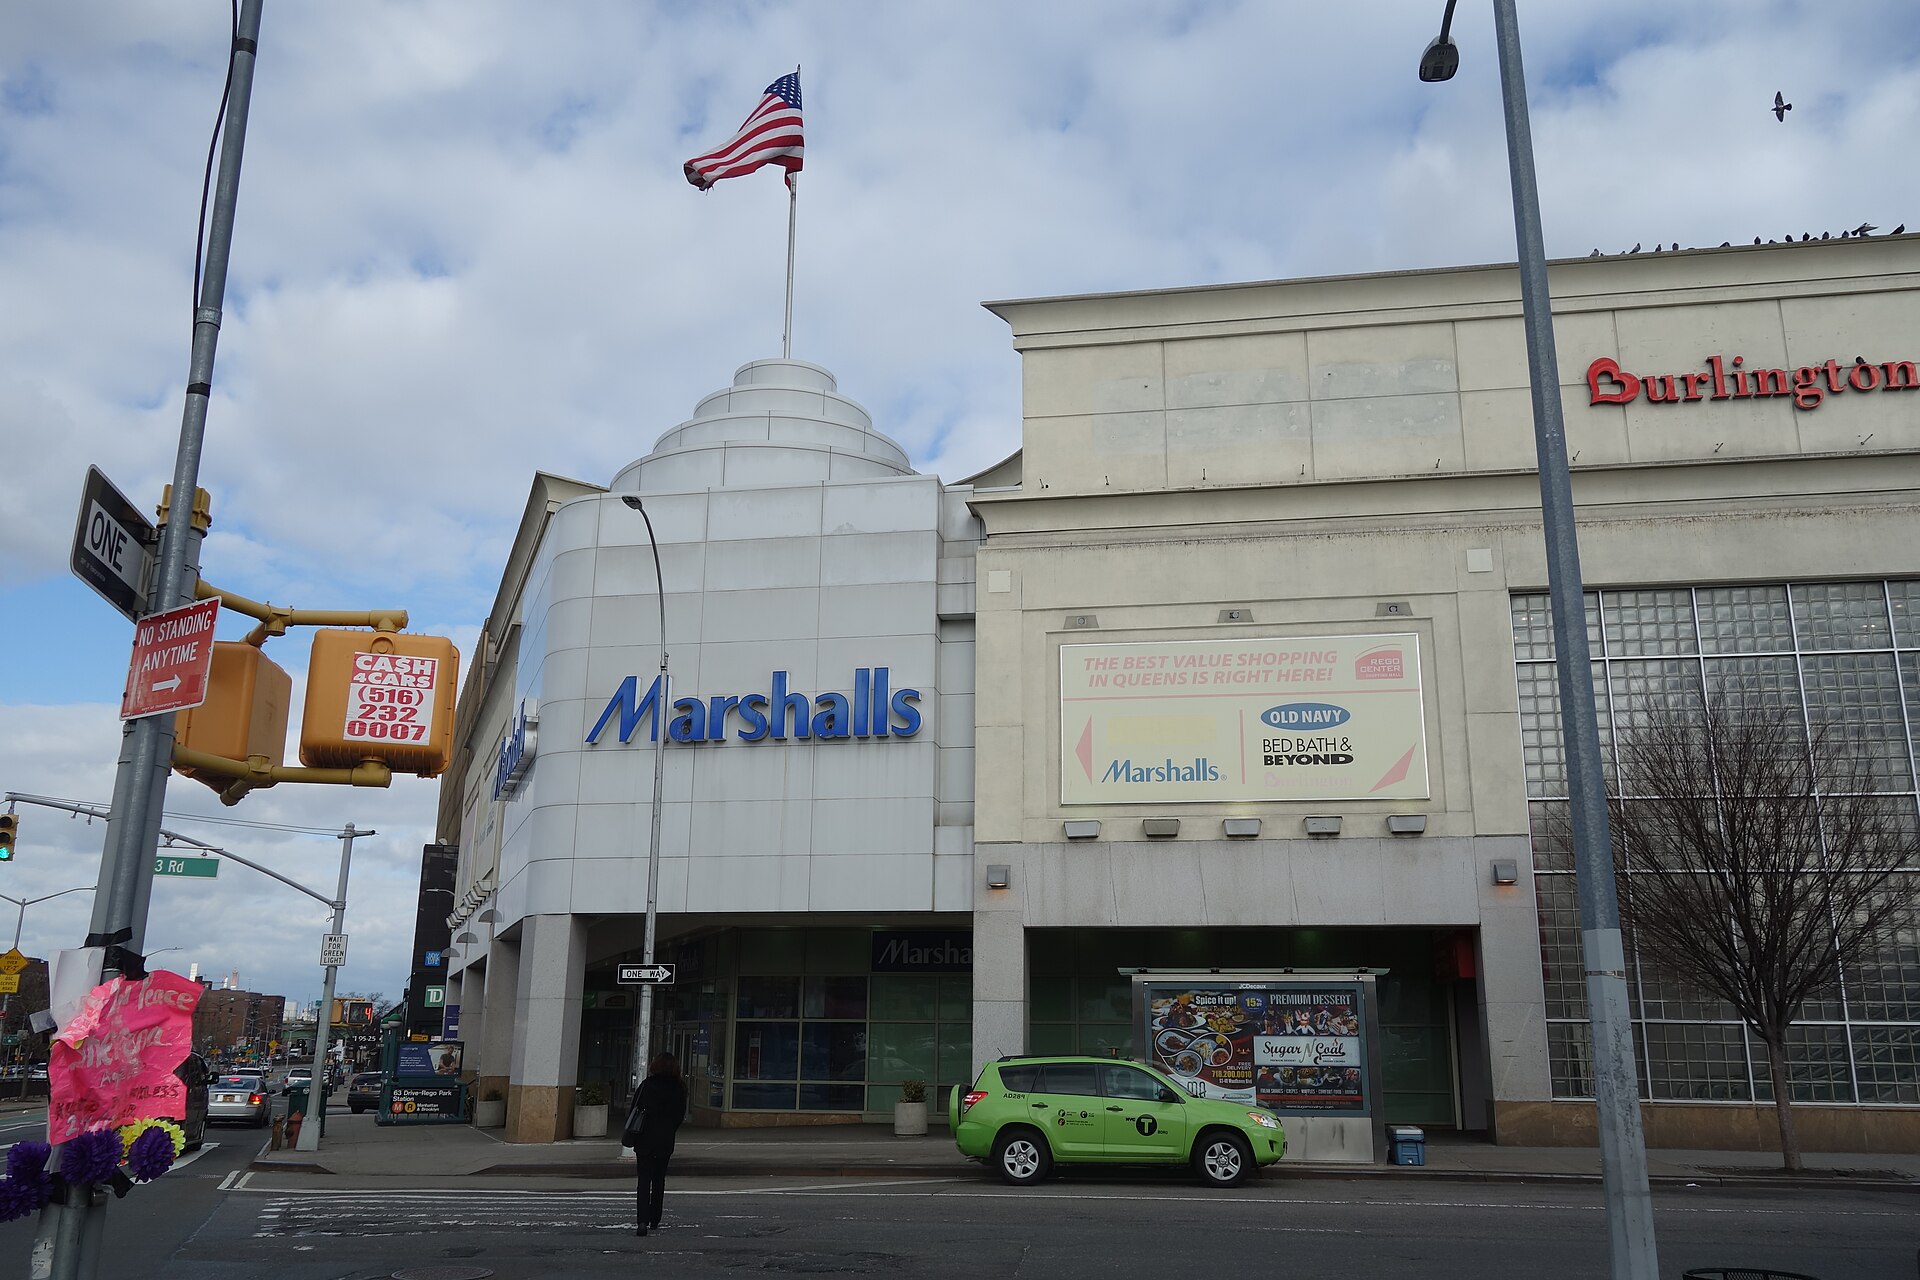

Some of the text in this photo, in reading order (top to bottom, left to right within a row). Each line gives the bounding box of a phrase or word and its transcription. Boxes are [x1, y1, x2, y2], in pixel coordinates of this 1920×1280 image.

[1587, 356, 1920, 410] Burlington
[91, 511, 127, 573] ONE
[138, 610, 212, 647] NO STANDING
[141, 641, 199, 673] ANYTIME
[1084, 651, 1338, 671] THE BEST VALUE SHOPPING
[1371, 658, 1400, 666] REGO
[353, 672, 430, 688] 4CARS
[1088, 668, 1333, 688] IN QUEENS IS RIGHT HERE!
[357, 686, 424, 706] (516)
[358, 703, 418, 723] 232
[585, 667, 923, 744] Marshalls
[1269, 709, 1342, 724] OLD NAVY
[347, 720, 426, 741] 0007
[1263, 736, 1352, 752] BED BATH &
[1263, 754, 1354, 766] BEYOND
[168, 860, 184, 872] Rd
[626, 970, 666, 978] ONE WAY
[427, 988, 443, 1003] TD
[1196, 996, 1236, 1005] Spice it up!
[1270, 994, 1351, 1005] PREMIUM DESSERT
[365, 1007, 372, 1020] 4
[1263, 1040, 1302, 1058] Sugar
[1314, 1042, 1346, 1064] Coal
[1140, 1118, 1152, 1134] T
